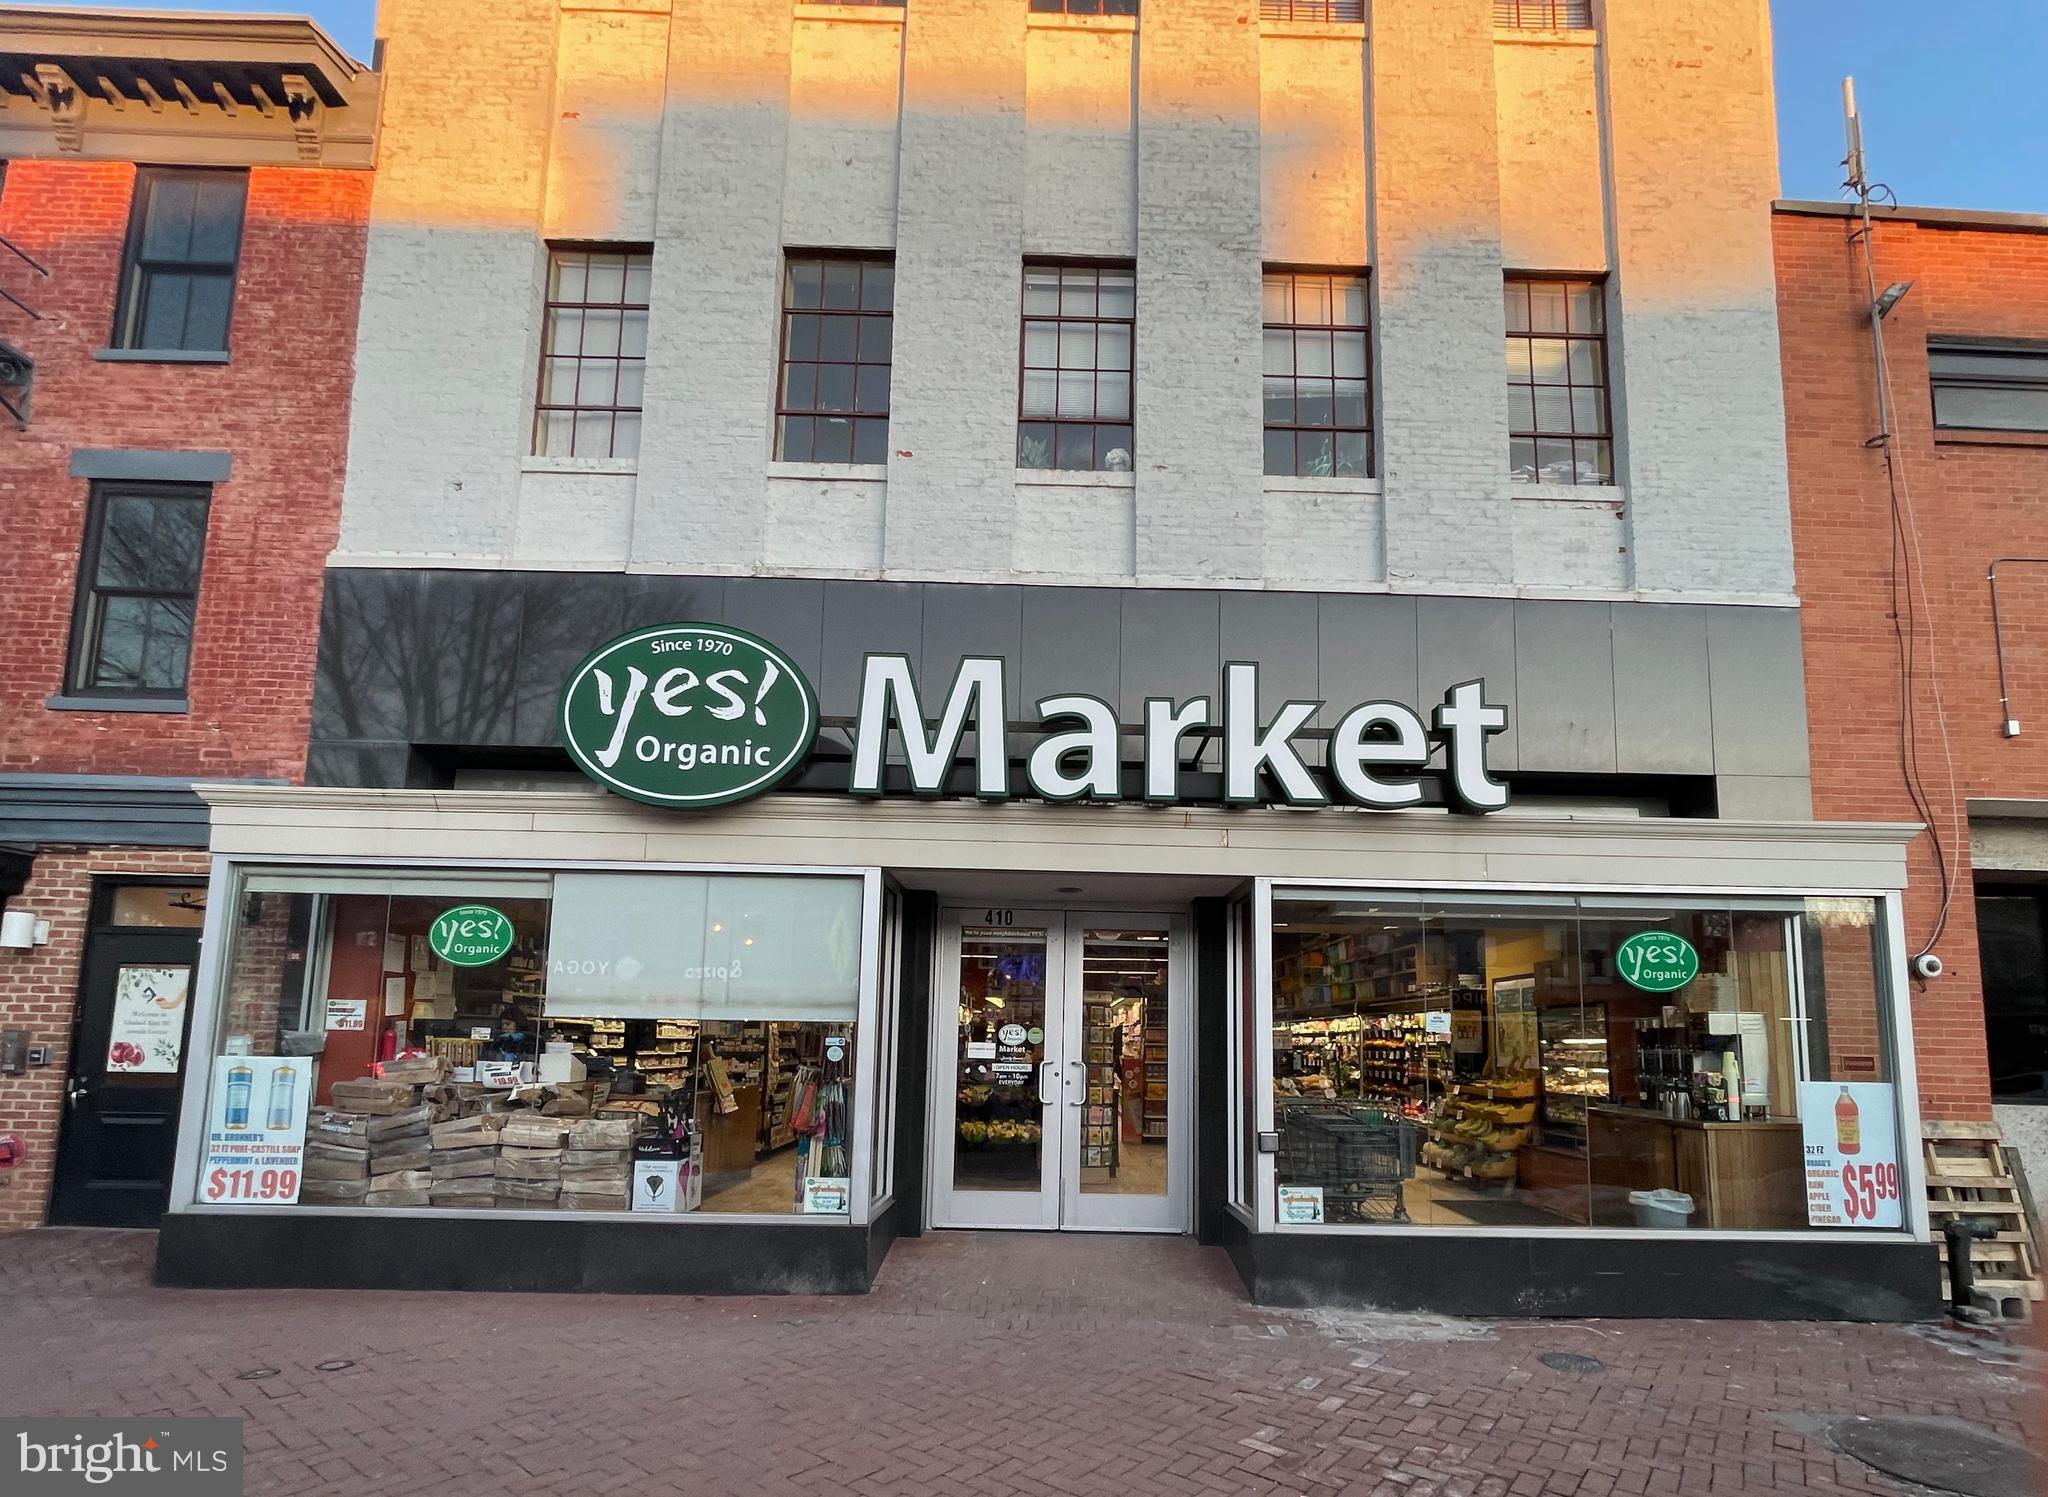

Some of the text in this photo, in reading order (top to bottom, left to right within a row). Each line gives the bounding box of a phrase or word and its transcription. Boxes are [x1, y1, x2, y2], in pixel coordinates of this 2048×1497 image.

[651, 639, 733, 656] Since 1970
[593, 660, 780, 768] yes!
[849, 651, 1510, 814] Market
[635, 735, 771, 771] Organic
[984, 909, 1013, 926] 410
[440, 916, 503, 955] yes!
[454, 943, 500, 955] Organic
[1625, 942, 1687, 981] yes!
[1643, 969, 1688, 981] Organic
[1002, 1028, 1023, 1042] yes!
[1806, 1145, 1814, 1154] 32
[1807, 1169, 1839, 1178] ORGANIC
[207, 1166, 297, 1200] $11.99
[1809, 1192, 1830, 1200] APPLE
